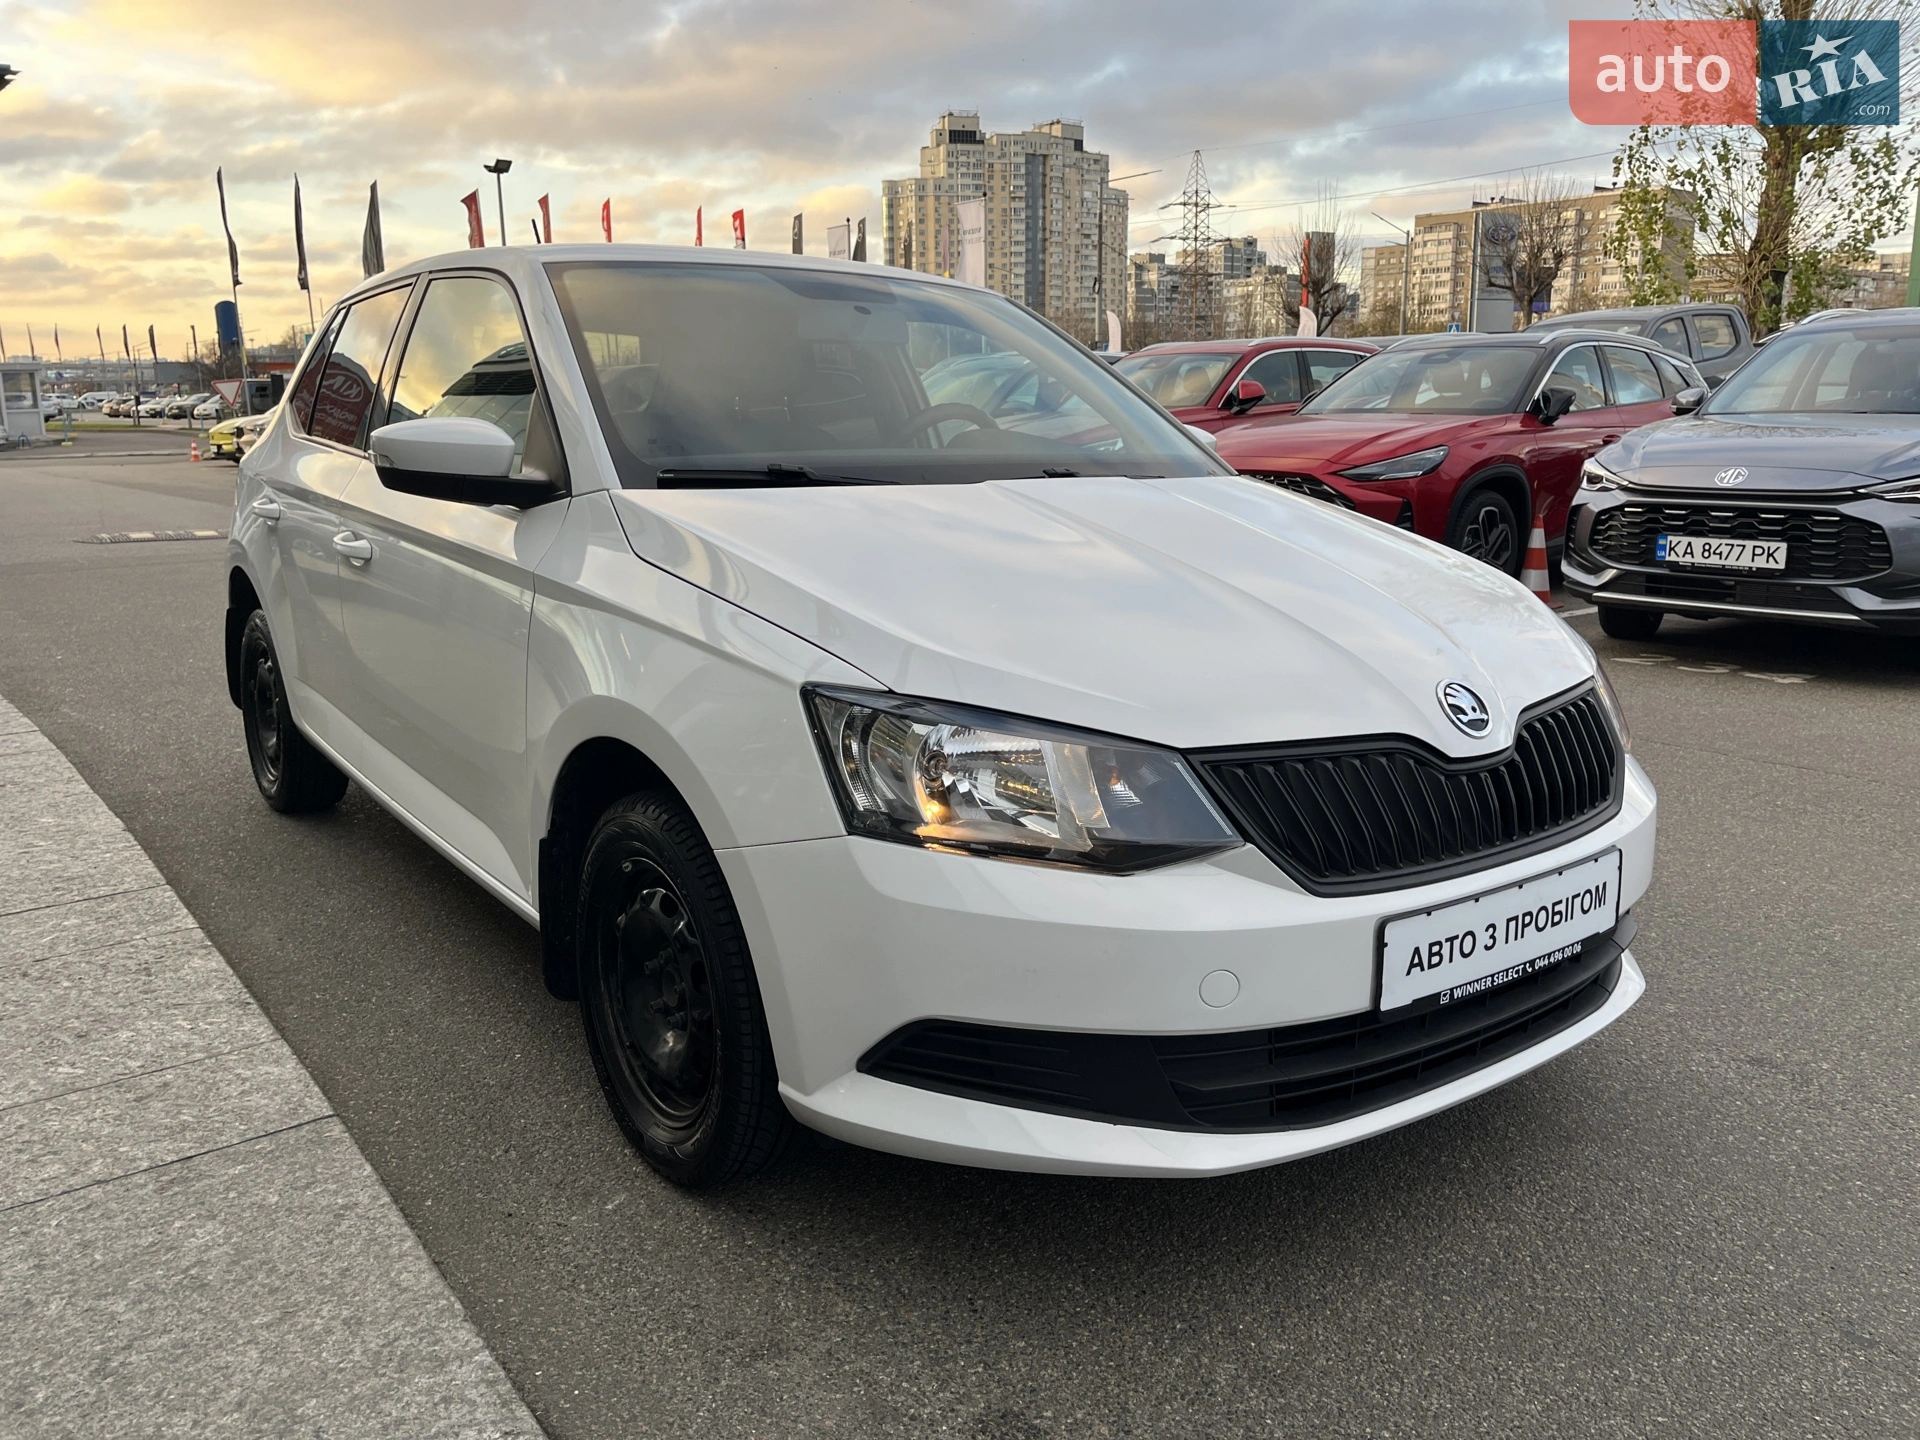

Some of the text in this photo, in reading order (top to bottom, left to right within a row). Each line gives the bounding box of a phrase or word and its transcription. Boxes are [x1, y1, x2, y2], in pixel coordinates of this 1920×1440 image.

[1717, 468, 1746, 484] MG
[1701, 542, 1747, 561] 8477
[1405, 930, 1477, 976] АВТО
[1504, 881, 1608, 945] ПРОБІГОМ
[1453, 977, 1492, 1000] WINNER
[1493, 965, 1524, 986] SELECT
[1534, 957, 1549, 970] 044
[1549, 949, 1564, 964] 496
